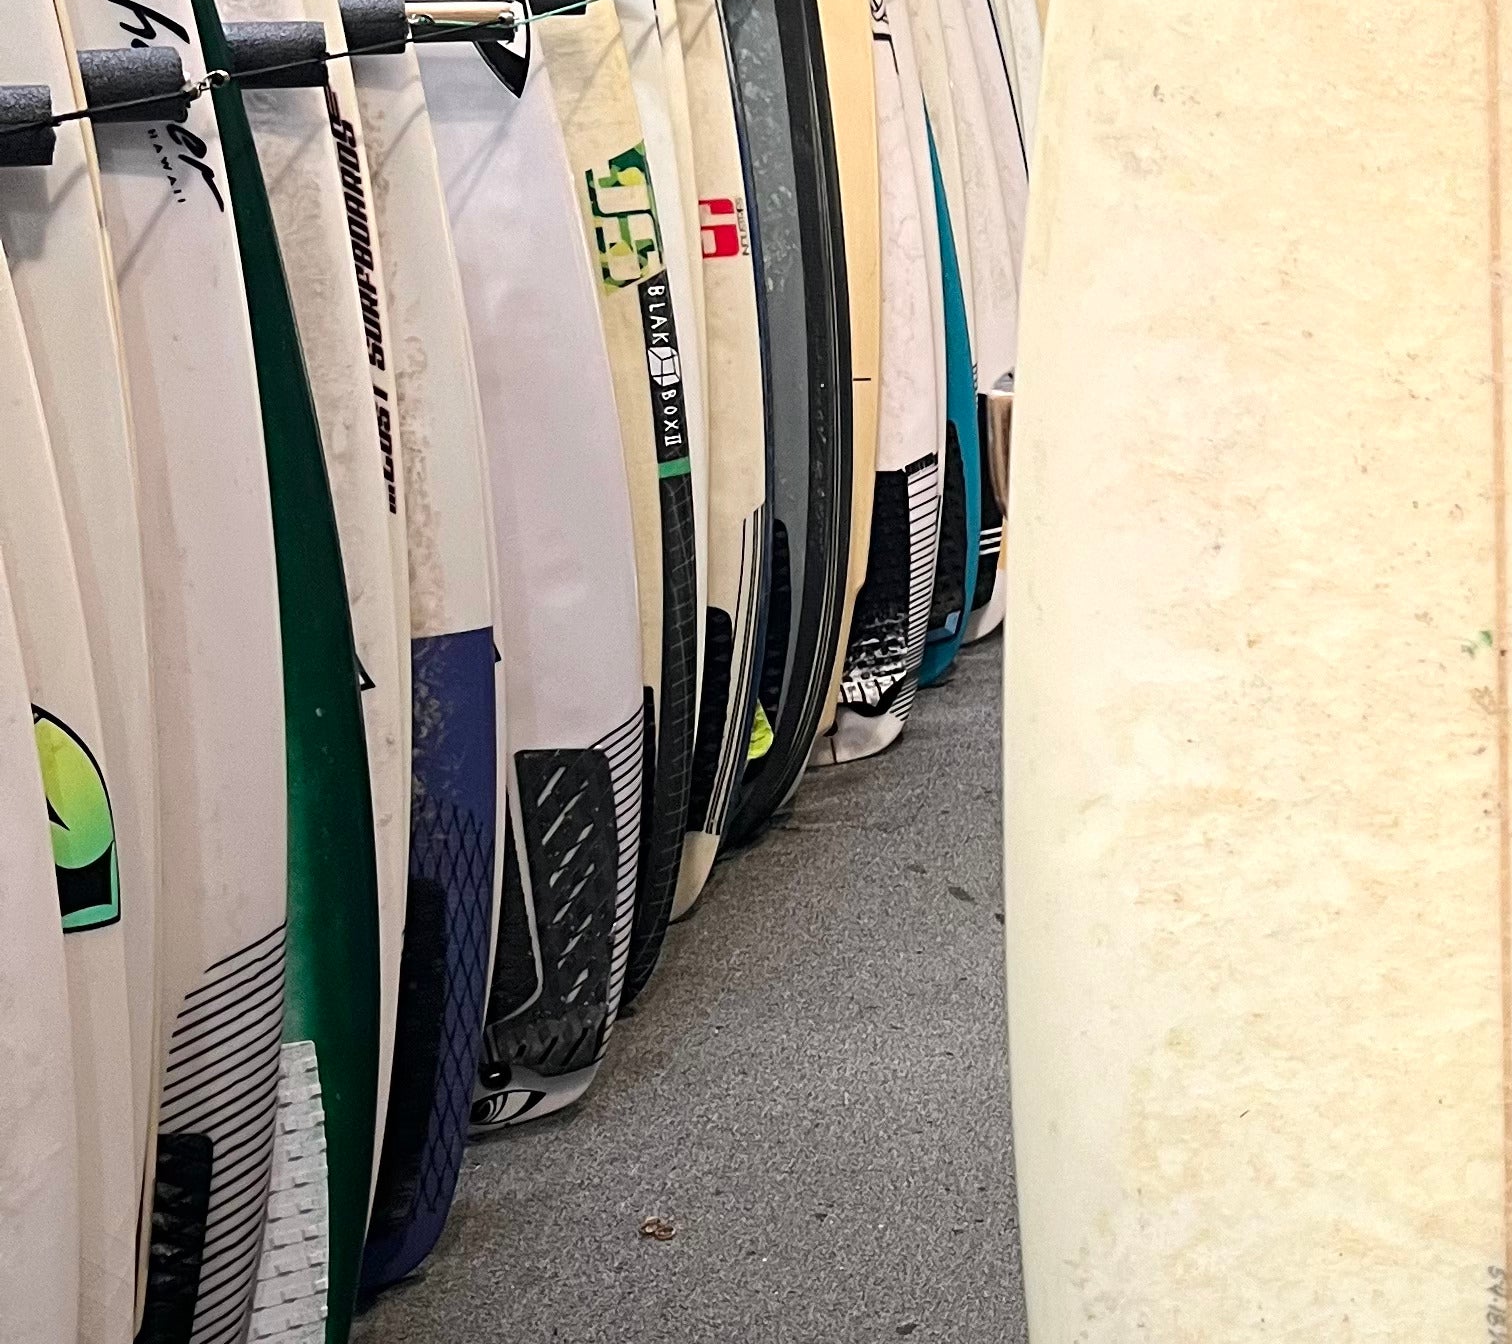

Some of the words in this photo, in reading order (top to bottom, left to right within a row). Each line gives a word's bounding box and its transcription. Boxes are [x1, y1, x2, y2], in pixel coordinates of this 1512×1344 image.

[147, 128, 187, 203] HAWAII
[331, 117, 386, 372] SURFBOARDS
[647, 284, 670, 345] BLAK
